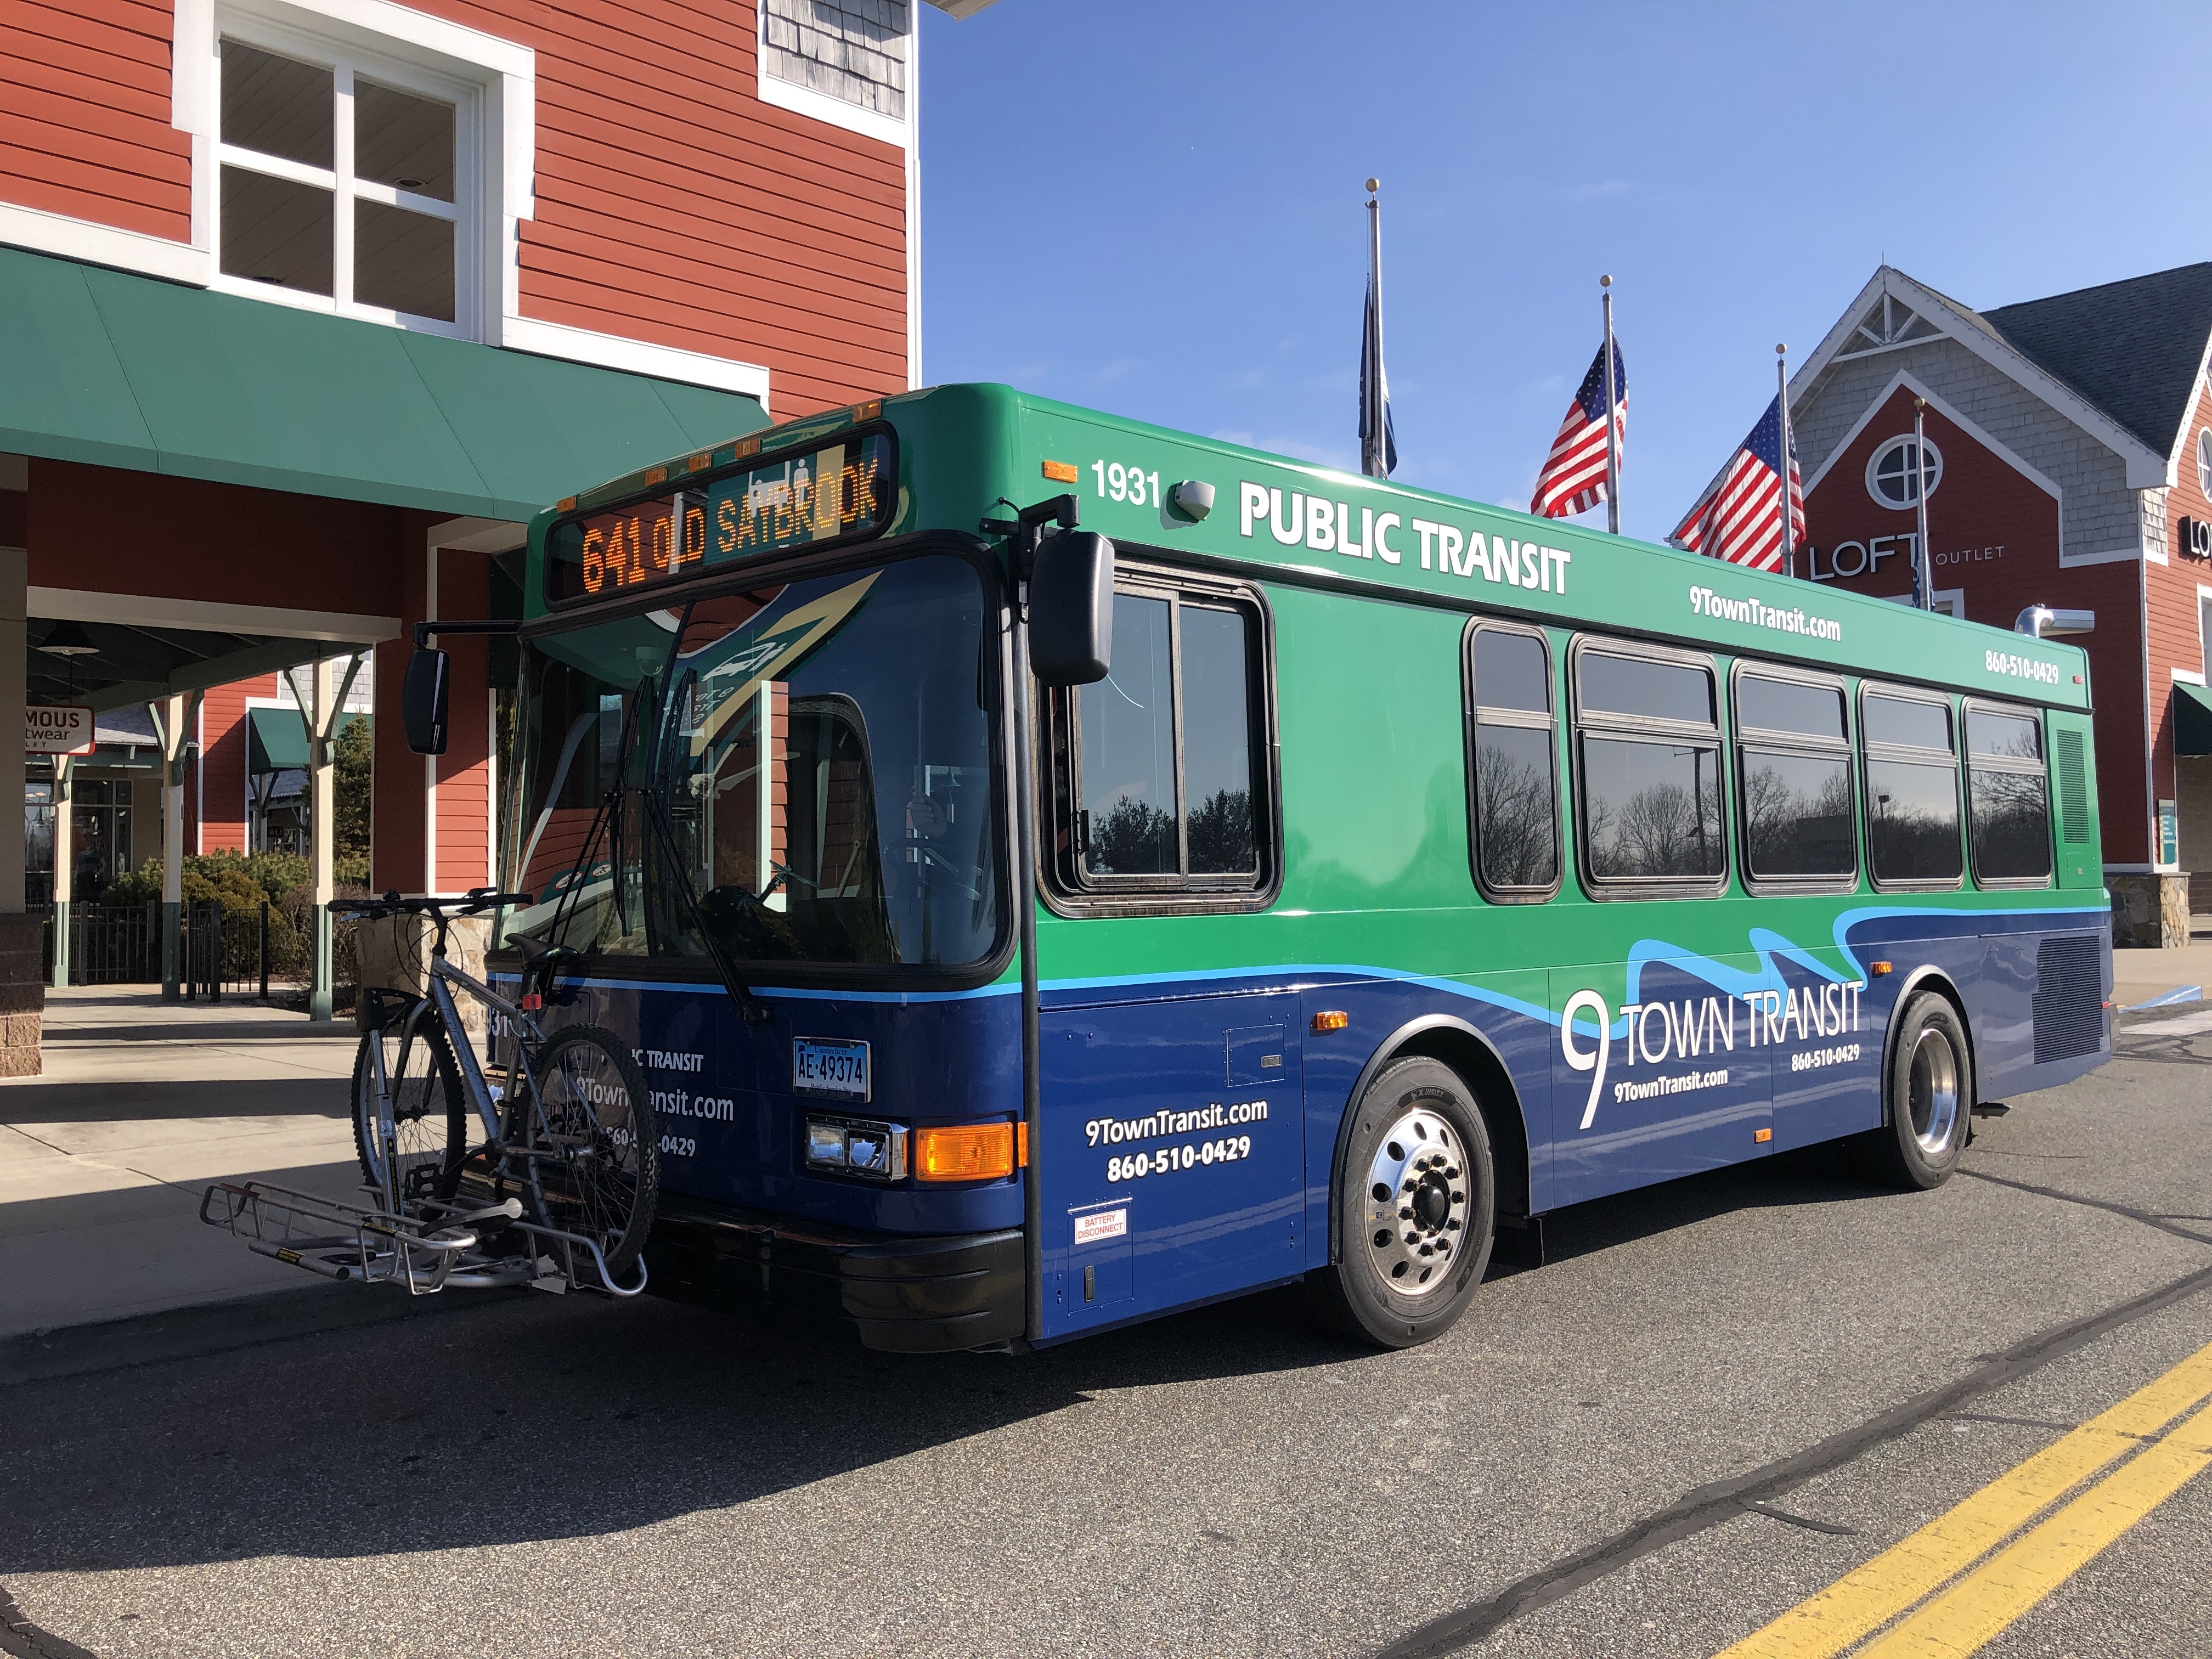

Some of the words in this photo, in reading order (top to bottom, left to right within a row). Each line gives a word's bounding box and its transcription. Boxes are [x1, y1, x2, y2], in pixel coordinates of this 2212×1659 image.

[1091, 459, 1160, 509] 1931
[583, 517, 645, 593] 641
[653, 507, 705, 569] OLD
[717, 459, 878, 552] SAYBROOK
[1239, 480, 1402, 566] PUBLIC
[1412, 517, 1571, 595] TRANSIT
[2190, 516, 2212, 557] LO
[1809, 532, 1918, 581] LOFT
[1935, 545, 2005, 566] OUTLET
[1689, 585, 1841, 642] 9TownTransit.com
[1985, 649, 2059, 685] 860-510-0429
[646, 1050, 704, 1072] TRANSIT
[814, 1045, 848, 1056] Connecticut
[1561, 989, 1611, 1130] 9
[1619, 995, 1734, 1066] TOWN
[1743, 980, 1864, 1047] TRANSIT
[1791, 1043, 1860, 1072] 860-510-0429
[1615, 1067, 1728, 1103] 9TownTransit.com
[1085, 1099, 1268, 1147] 9TownTransit.com
[1107, 1136, 1251, 1183] 860-510-0429
[1078, 1222, 1123, 1239] DISCONNECT
[1085, 1214, 1116, 1227] BATTERY
